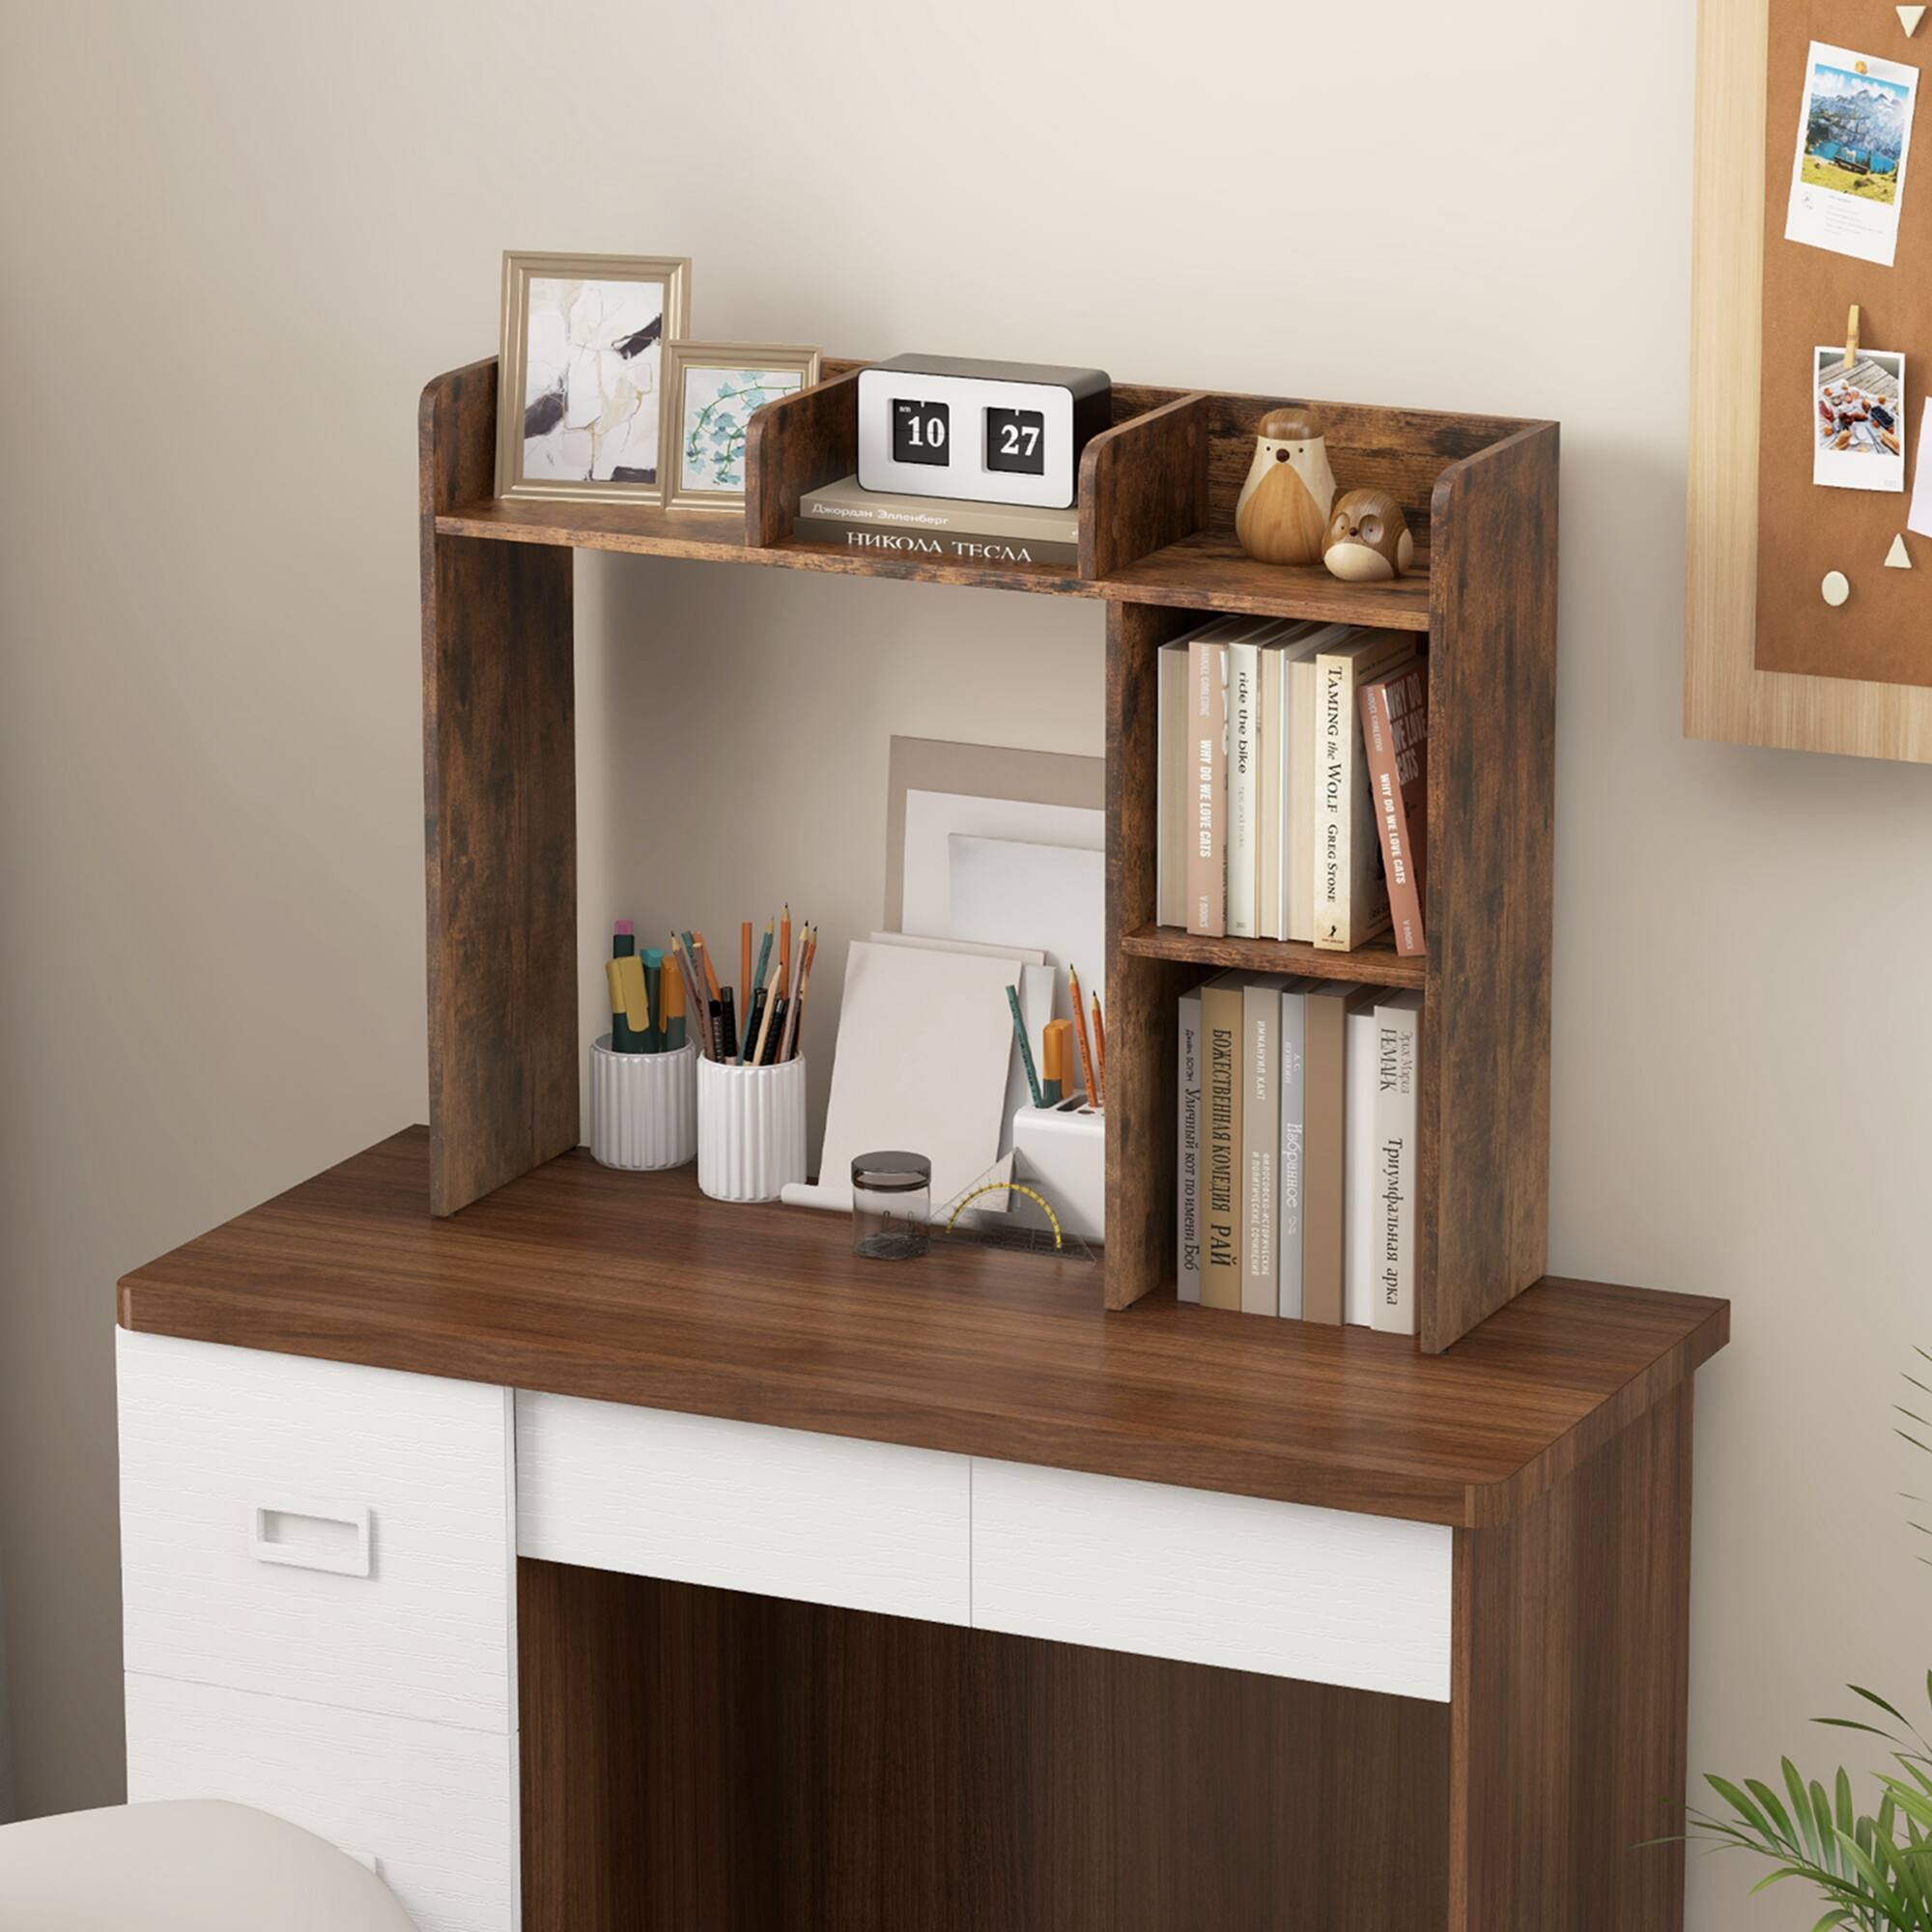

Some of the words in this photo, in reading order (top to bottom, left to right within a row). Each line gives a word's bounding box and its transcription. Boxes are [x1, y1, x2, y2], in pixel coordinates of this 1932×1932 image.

[907, 415, 945, 448] 10
[1000, 424, 1040, 457] 27
[811, 502, 873, 519] Джордан
[877, 509, 950, 527] Элленберг
[846, 531, 943, 554] НИКОЛА
[952, 541, 1033, 563] ТЕСЛА
[1238, 672, 1249, 703] ride
[1327, 667, 1343, 736] TAMING
[1238, 709, 1248, 735] the
[1200, 739, 1213, 764] WHY
[1238, 740, 1248, 774] bike
[1327, 741, 1339, 760] the
[1200, 766, 1212, 781] DO
[1327, 763, 1341, 813] WOLF
[1379, 774, 1393, 797] WHY
[1200, 783, 1212, 801] WE
[1383, 798, 1395, 813] DO
[1200, 803, 1212, 830] LOVE
[1385, 814, 1398, 831] WE
[1200, 831, 1212, 858] CATS
[1326, 824, 1339, 859] GREG
[1388, 832, 1402, 857] LOVE
[1326, 862, 1339, 903] STONE
[1393, 859, 1406, 885] CATS
[1379, 1028, 1397, 1093] РЕМАРК
[1212, 1029, 1233, 1141] БОЖЕСТВЕННАЯ
[1183, 1088, 1201, 1150] Уличный
[1184, 1152, 1197, 1176] кот
[1209, 1144, 1232, 1212] КОМЕДИЯ
[1282, 1122, 1302, 1208] Избранное
[1183, 1179, 1195, 1196] по
[1382, 1137, 1405, 1262] Триумфальная
[1183, 1197, 1196, 1241] имени
[1183, 1243, 1200, 1271] Боб
[1210, 1223, 1236, 1267] РАЙ
[1382, 1267, 1400, 1305] арка
